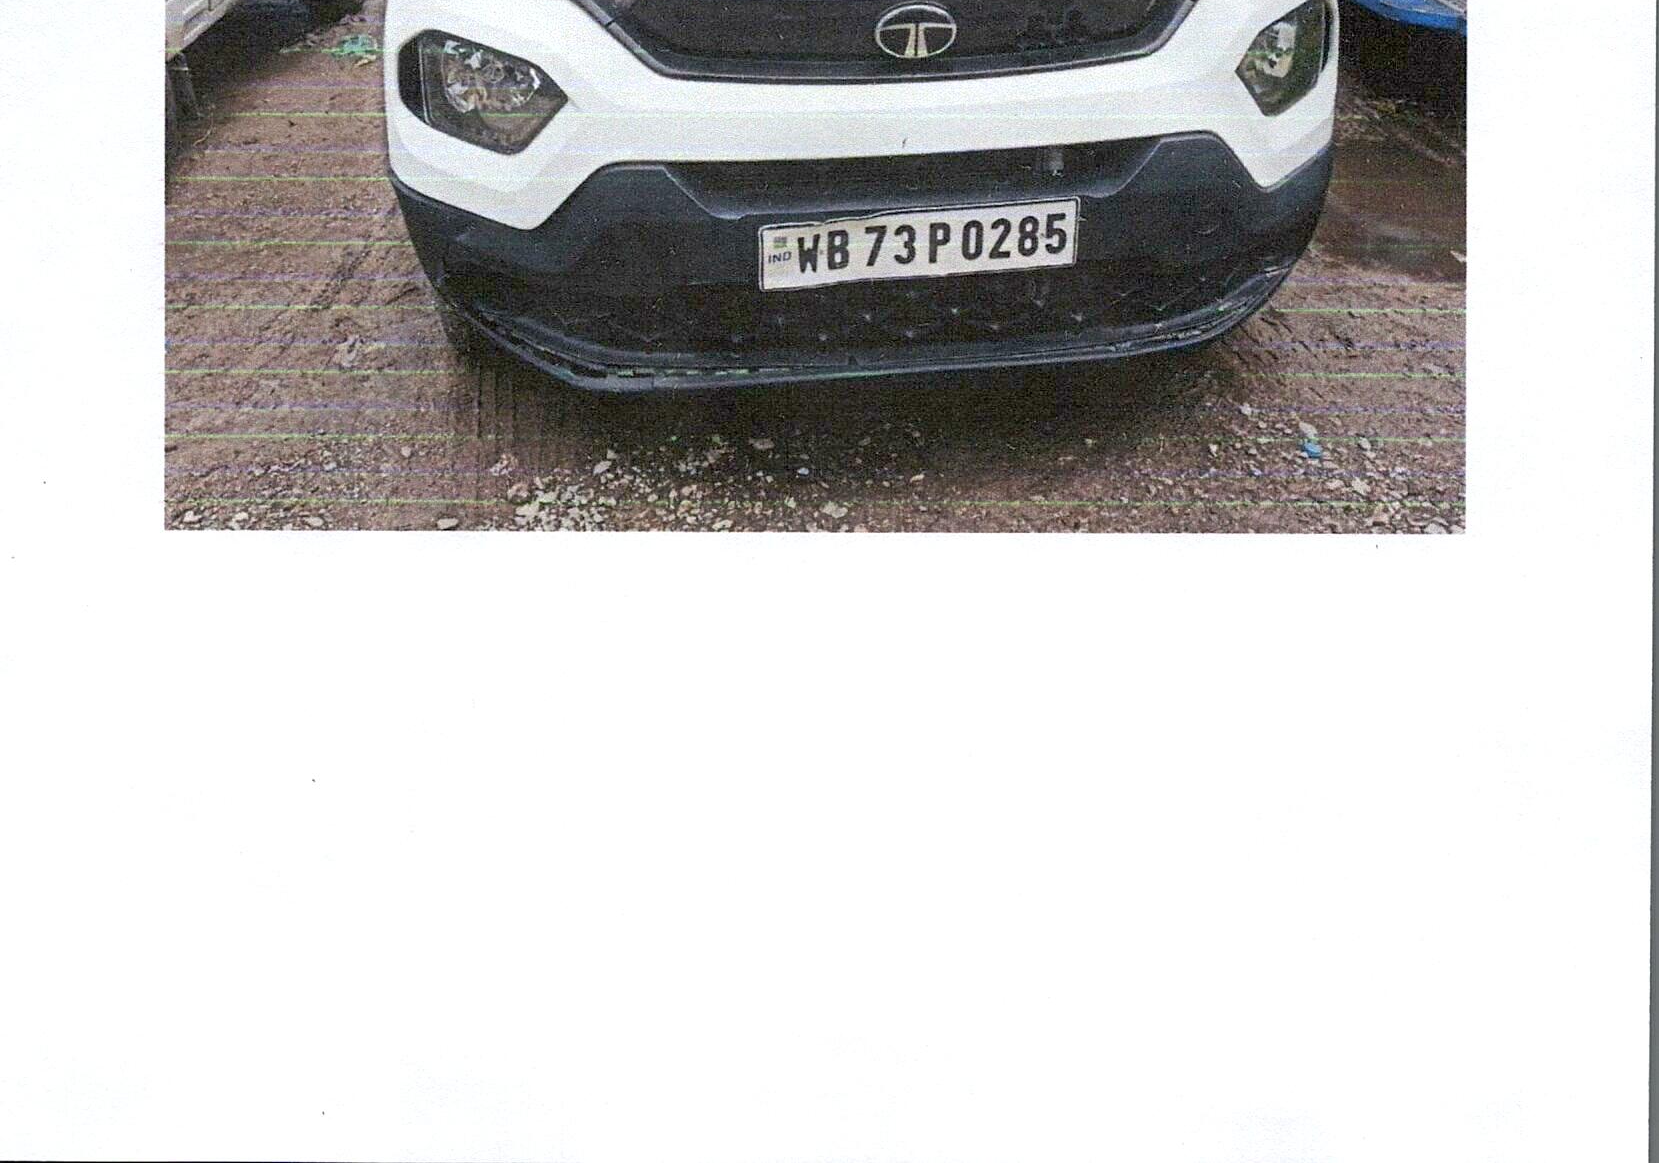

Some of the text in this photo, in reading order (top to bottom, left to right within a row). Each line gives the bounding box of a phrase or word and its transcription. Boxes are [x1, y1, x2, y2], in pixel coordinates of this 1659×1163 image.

[768, 251, 791, 264] IND
[797, 230, 849, 273] WB
[865, 225, 916, 266] 73
